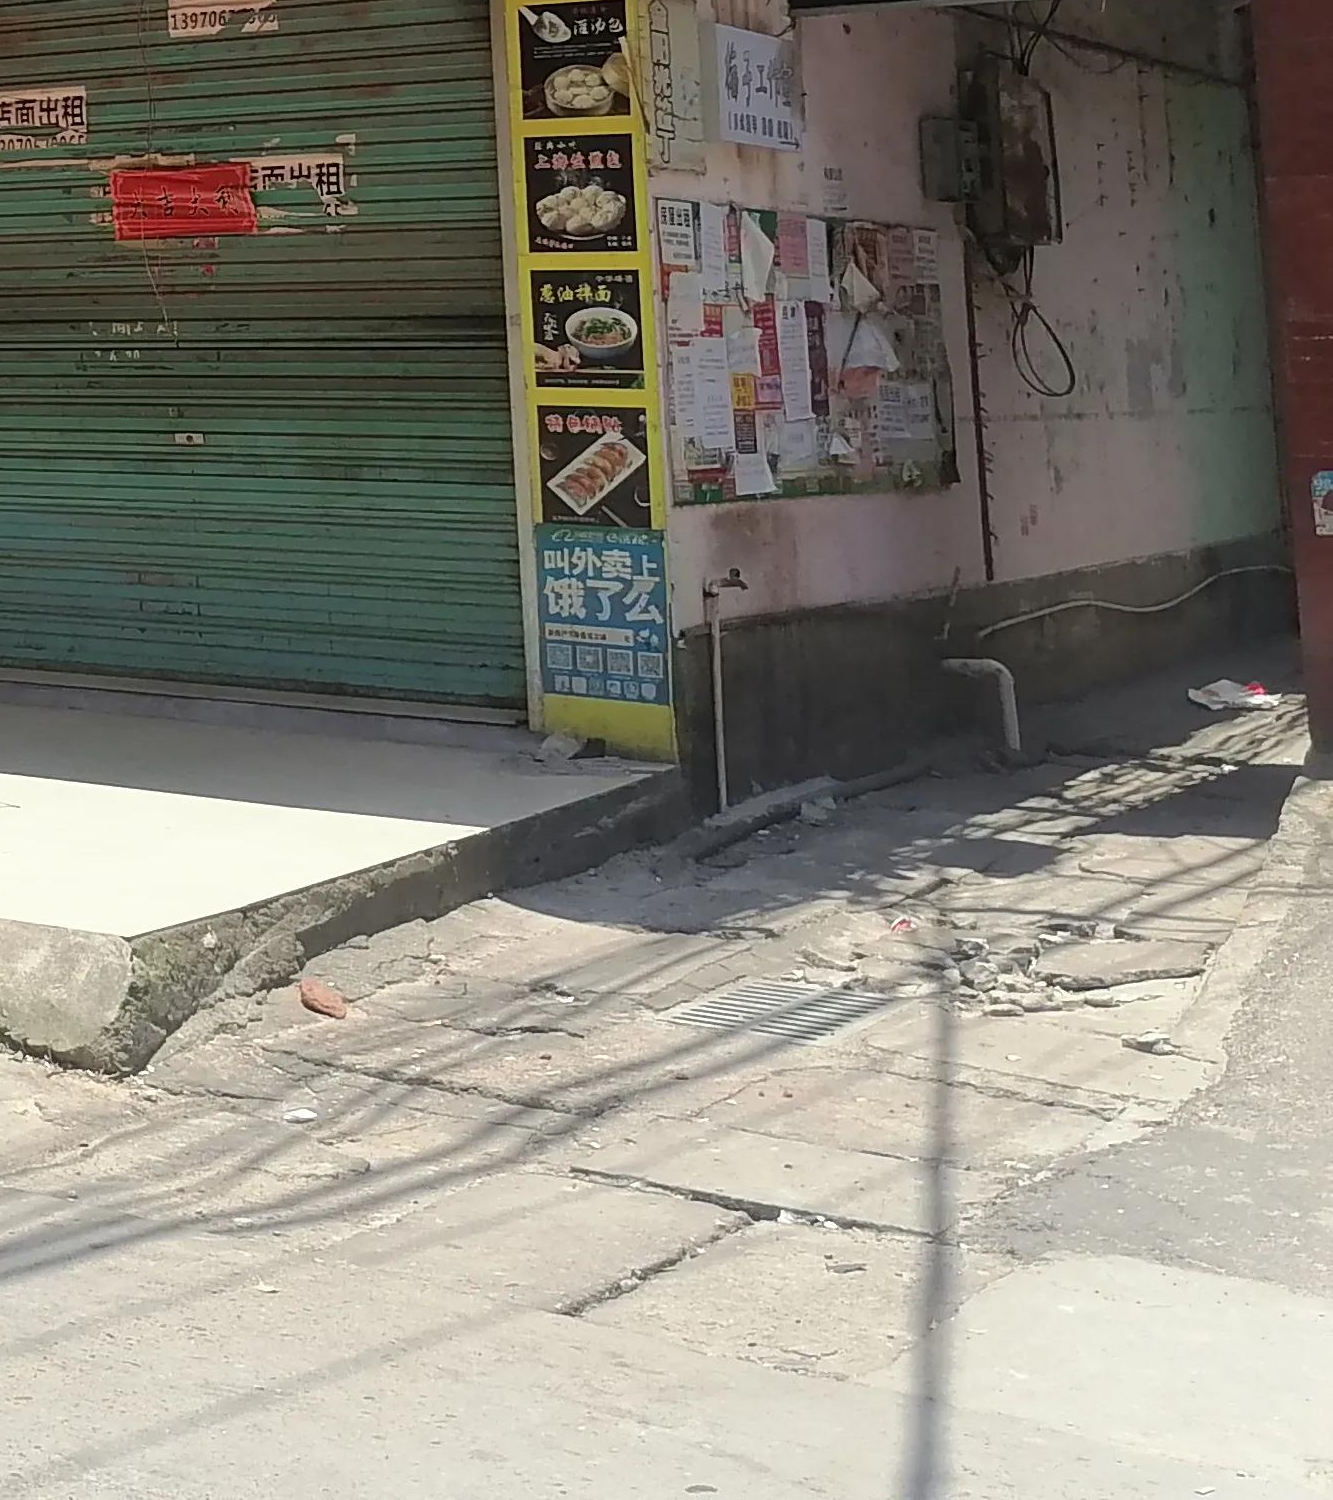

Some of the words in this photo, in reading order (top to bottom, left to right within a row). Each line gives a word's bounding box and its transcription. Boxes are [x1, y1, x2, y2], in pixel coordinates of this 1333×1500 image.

[543, 547, 660, 582] 叫外卖上
[543, 576, 664, 625] 饿了么
